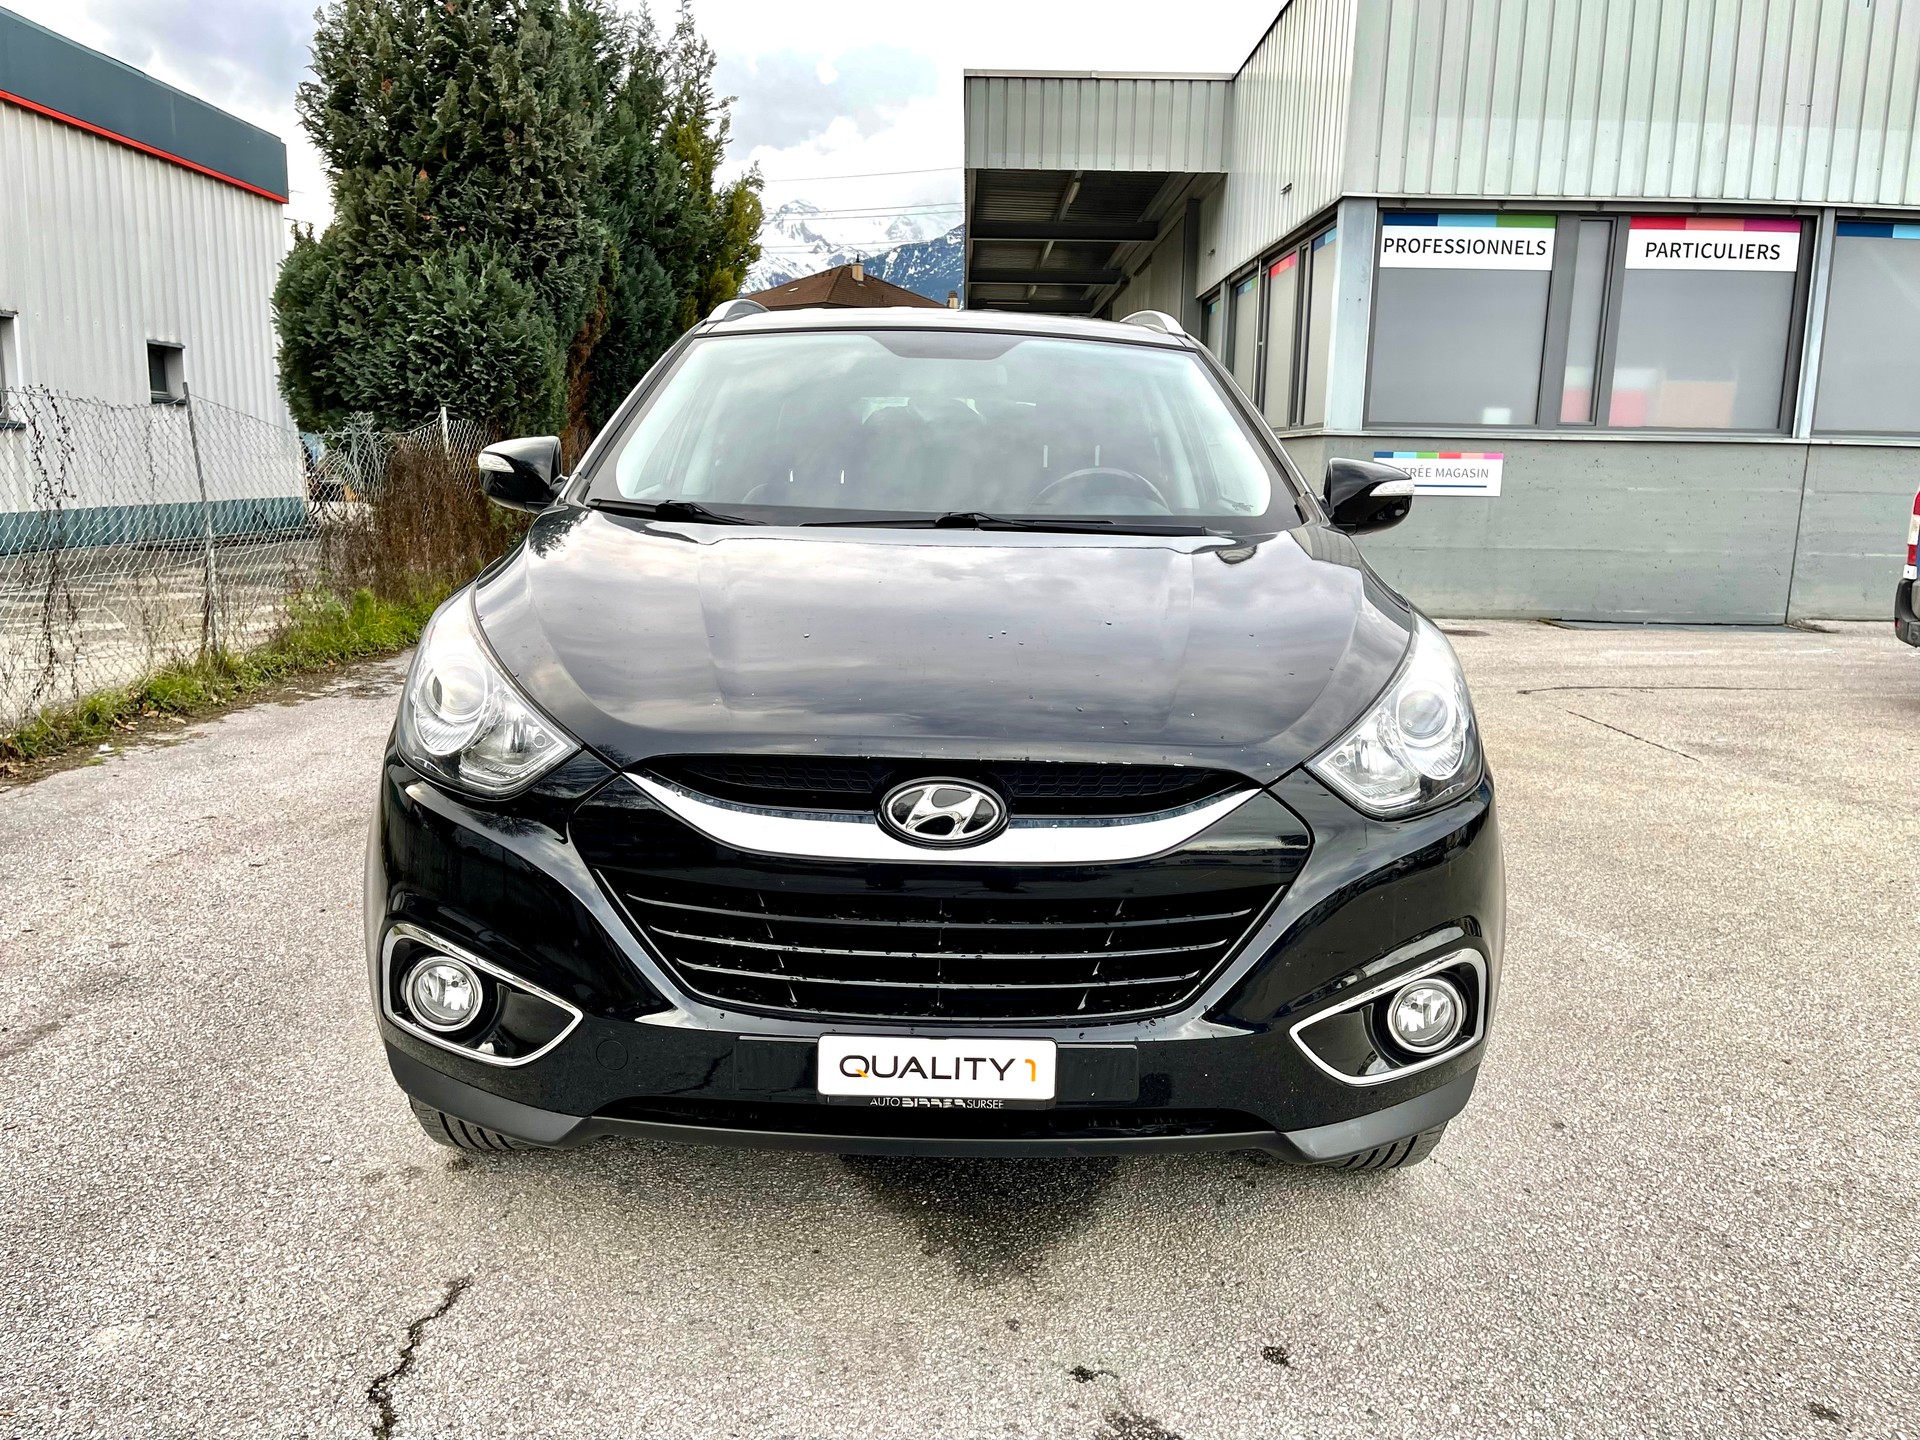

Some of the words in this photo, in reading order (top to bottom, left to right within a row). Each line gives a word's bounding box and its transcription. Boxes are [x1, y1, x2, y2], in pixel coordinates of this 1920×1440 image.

[1383, 237, 1547, 256] PROFESSIONNELS
[1645, 242, 1781, 260] PARTICULIERS
[1401, 464, 1432, 478] TRÉE
[1435, 467, 1489, 479] MAGASIN
[839, 1054, 1016, 1081] QUALITY
[1024, 1058, 1037, 1082] 1
[869, 1096, 901, 1107] AUTO
